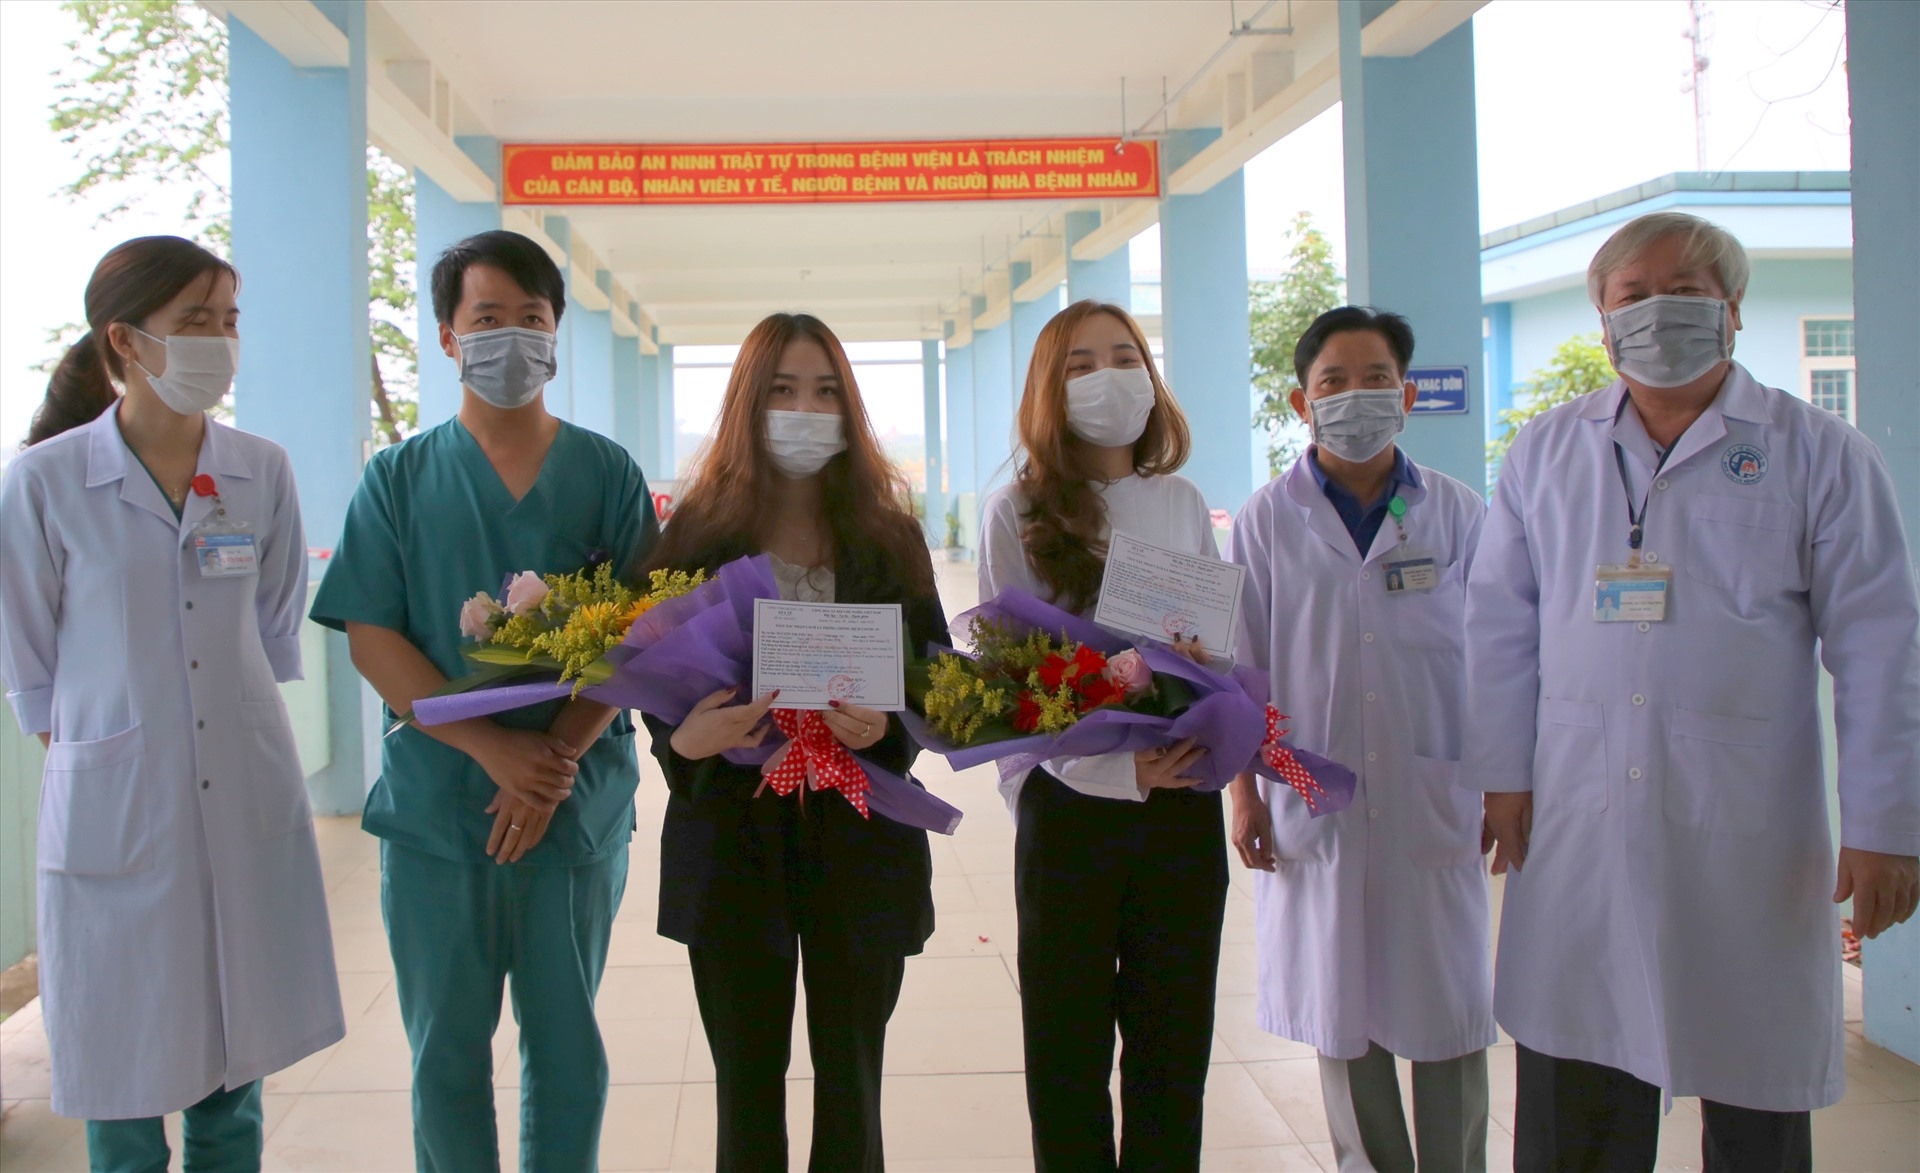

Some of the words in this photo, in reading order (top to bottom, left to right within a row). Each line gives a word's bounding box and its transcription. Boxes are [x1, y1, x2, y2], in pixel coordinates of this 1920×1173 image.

[551, 151, 594, 170] ĐẢM
[598, 150, 636, 170] BẢO
[641, 154, 666, 170] AN
[670, 154, 716, 170] NINH
[720, 151, 764, 173] TRẬT
[768, 152, 793, 172] TỰ
[795, 153, 855, 169] TRONG
[860, 149, 907, 171] BỆNH
[912, 149, 953, 171] VIỆN
[957, 147, 980, 167] LÀ
[984, 147, 1041, 166] TRÁCH
[1046, 146, 1104, 168] NHIỆM
[524, 174, 561, 195] CỦA
[565, 176, 604, 194] CÁN
[608, 175, 638, 197] BỘ,
[643, 175, 695, 194] NHÂN
[700, 175, 740, 194] VIÊN
[745, 178, 756, 193] Y
[761, 173, 787, 194] TẾ,
[792, 173, 847, 193] NGƯỜI
[852, 173, 900, 196] BỆNH
[904, 172, 928, 191] VÀ
[933, 171, 988, 190] NGƯỜI
[993, 170, 1030, 189] NHÀ
[1035, 170, 1083, 191] BỆNH
[1087, 169, 1138, 188] NHÂN
[1417, 377, 1440, 394] KHẠC
